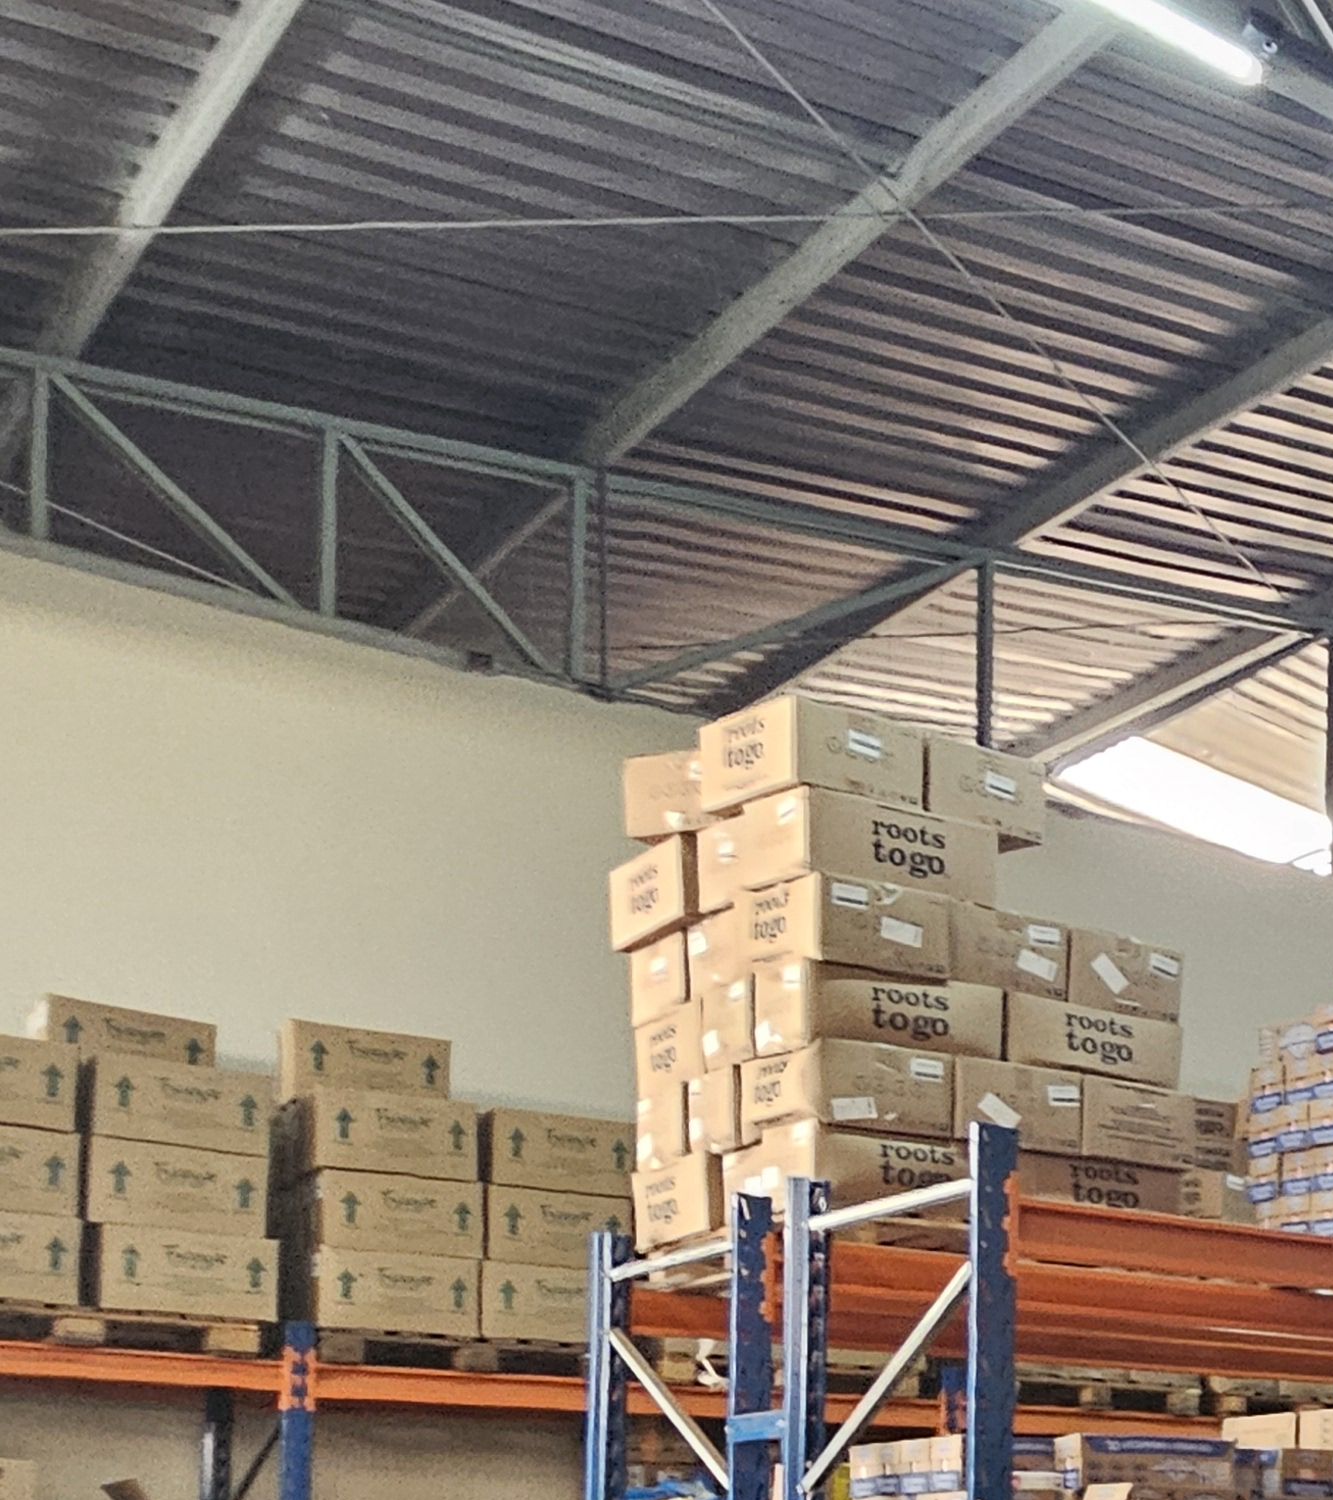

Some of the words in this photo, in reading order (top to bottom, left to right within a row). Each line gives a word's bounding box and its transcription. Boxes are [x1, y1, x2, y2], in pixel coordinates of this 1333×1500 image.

[726, 742, 765, 770] togo
[872, 819, 946, 850] roots
[872, 838, 946, 879] togo
[872, 986, 949, 1012] roots
[872, 1003, 950, 1041] togo
[1065, 1012, 1135, 1039] roots
[1065, 1029, 1133, 1065] togo
[881, 1143, 955, 1166] roots
[1069, 1163, 1139, 1186] roots
